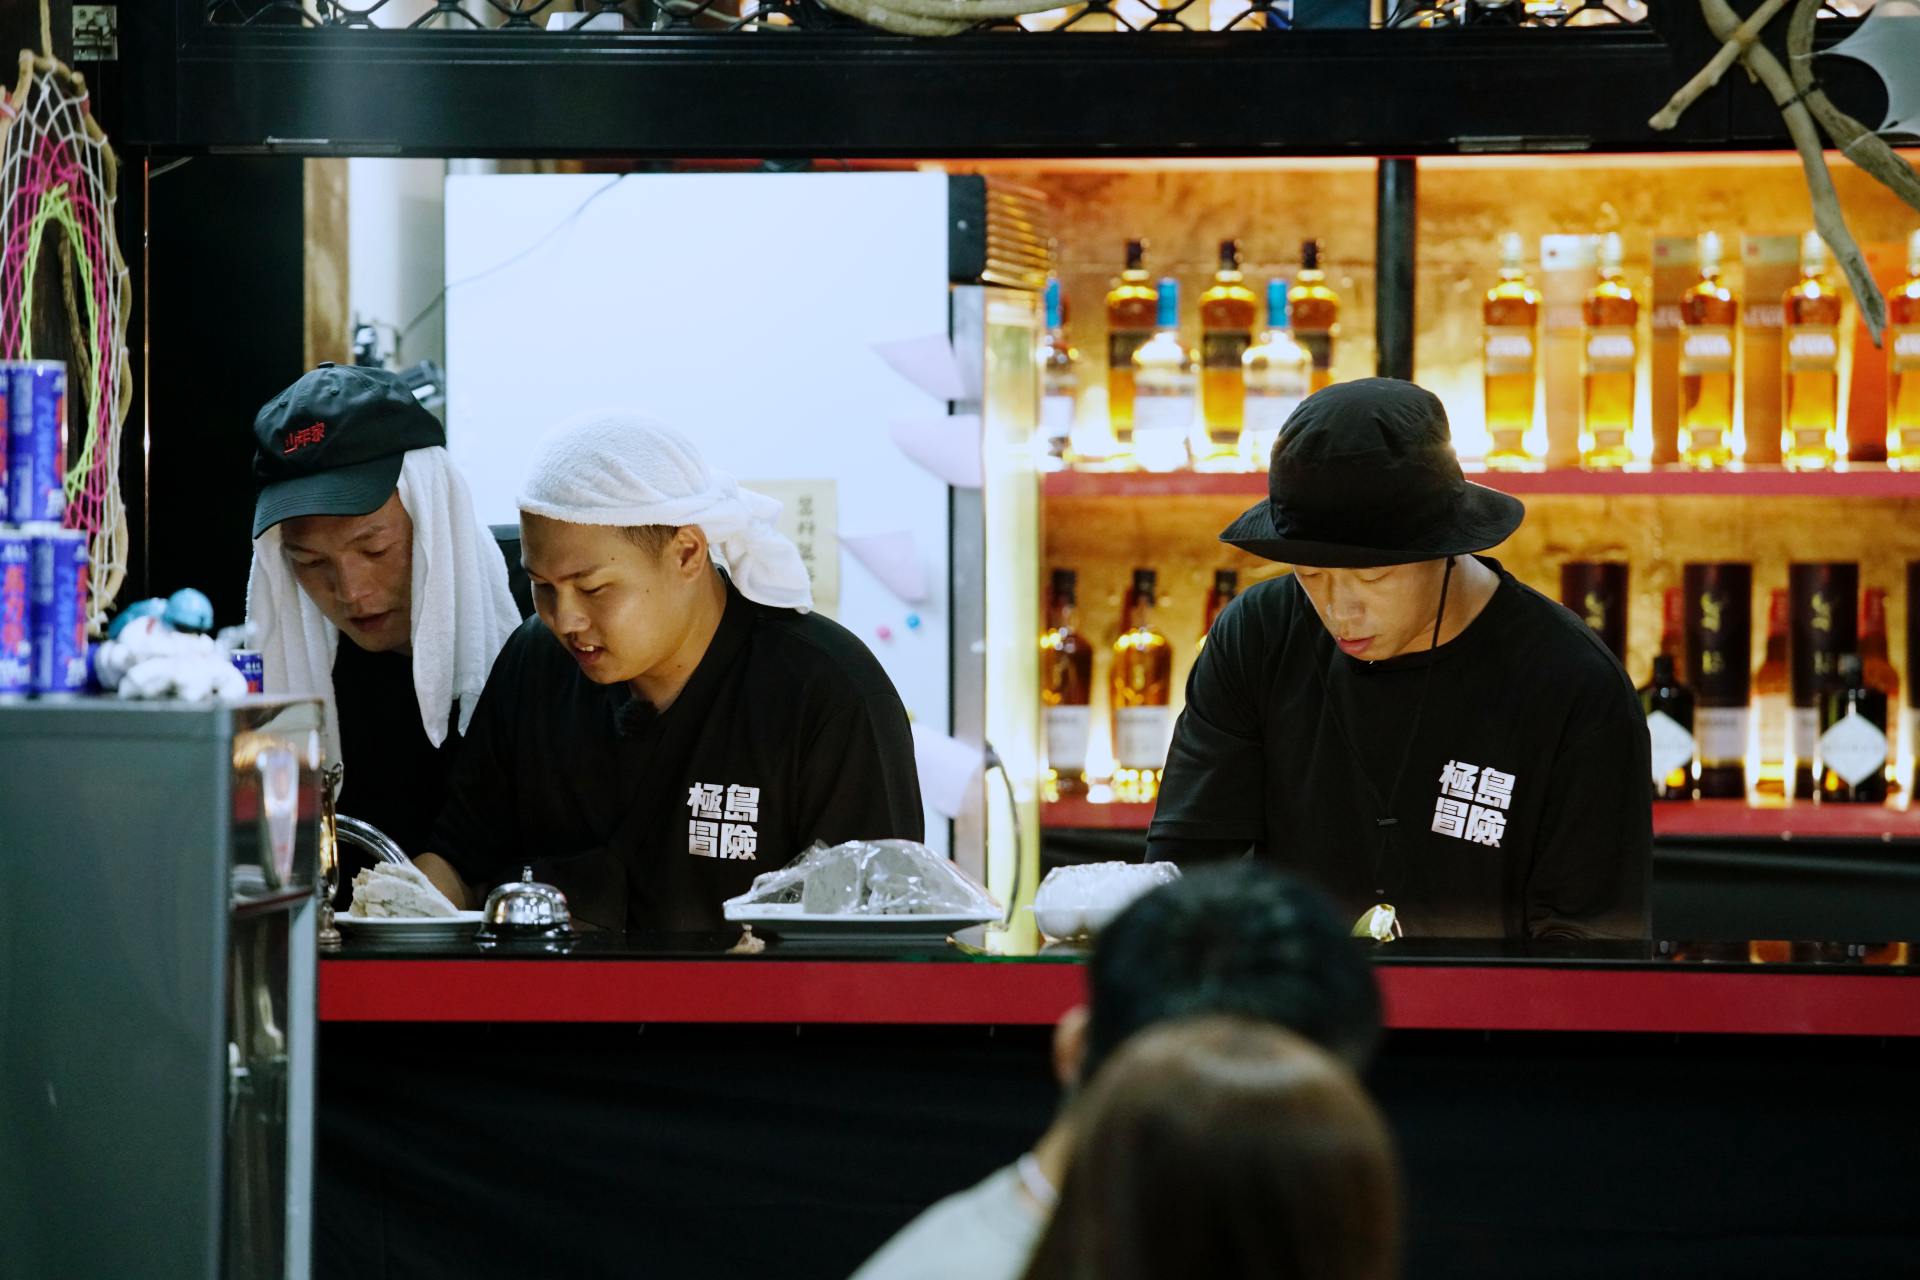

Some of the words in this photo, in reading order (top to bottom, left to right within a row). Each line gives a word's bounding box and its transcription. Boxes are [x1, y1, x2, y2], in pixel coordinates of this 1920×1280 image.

[686, 782, 760, 823] 極島
[1439, 759, 1516, 810] 極島
[688, 819, 758, 861] 冒險
[1431, 796, 1507, 848] 冒險
